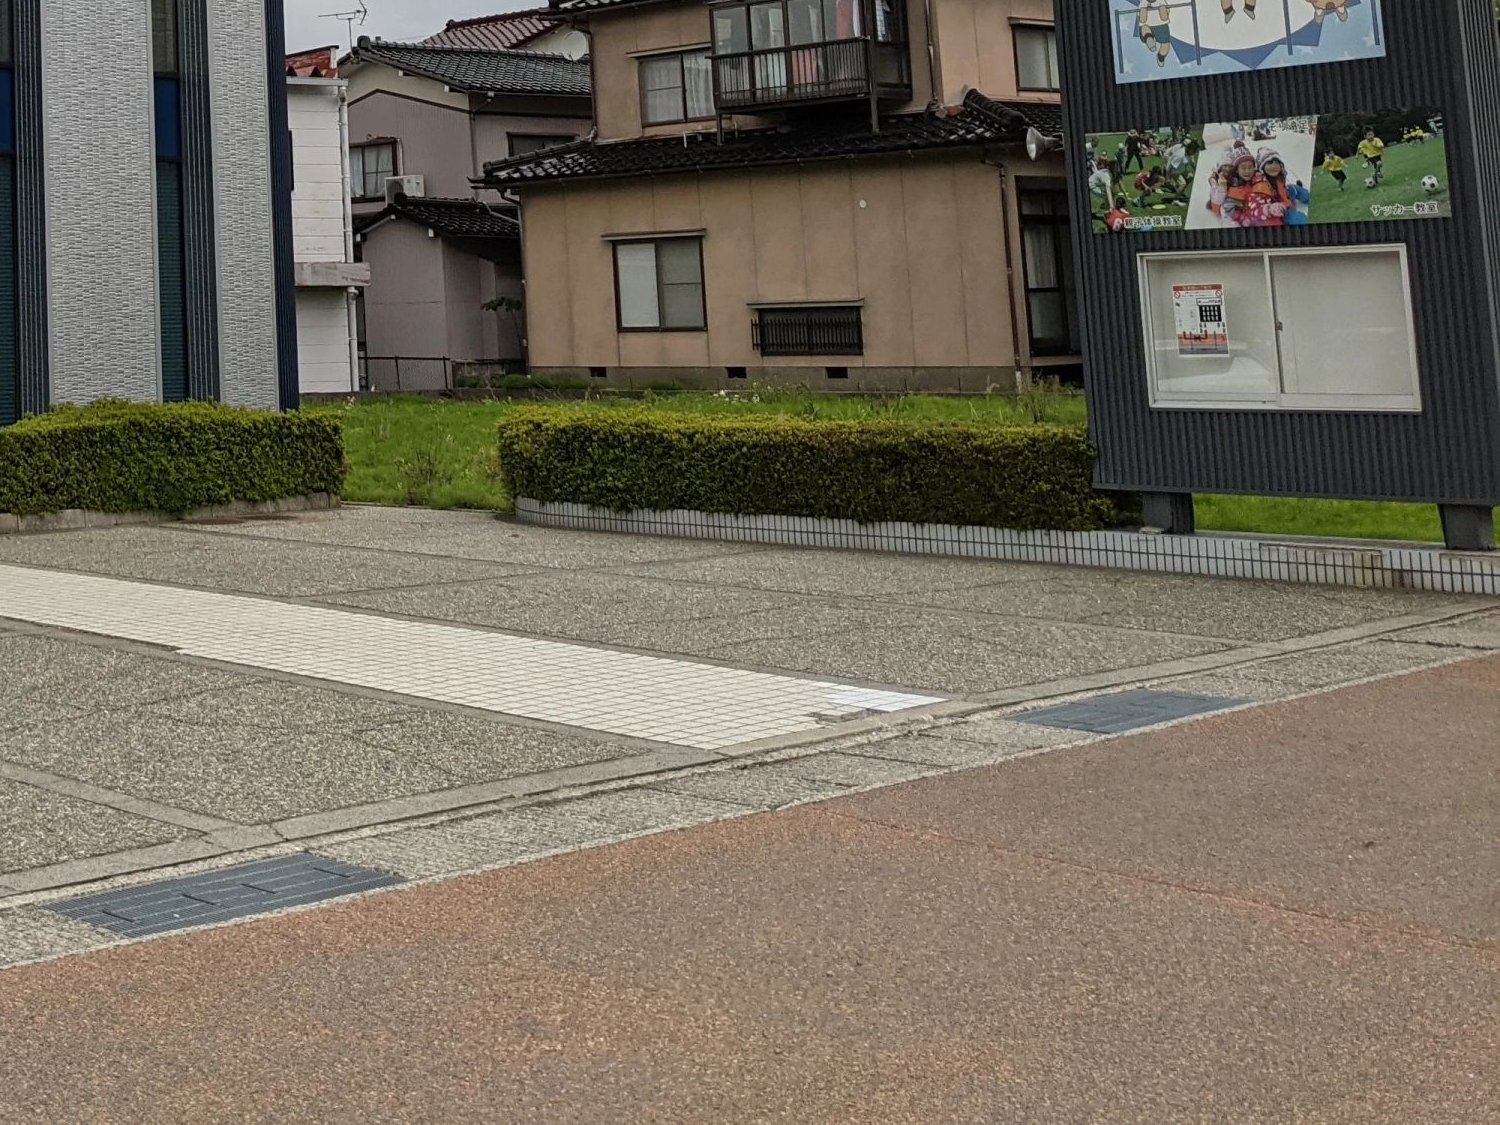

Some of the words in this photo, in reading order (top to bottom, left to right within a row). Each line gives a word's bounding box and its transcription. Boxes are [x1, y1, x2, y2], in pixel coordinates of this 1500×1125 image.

[1370, 201, 1438, 217] サッカー教室
